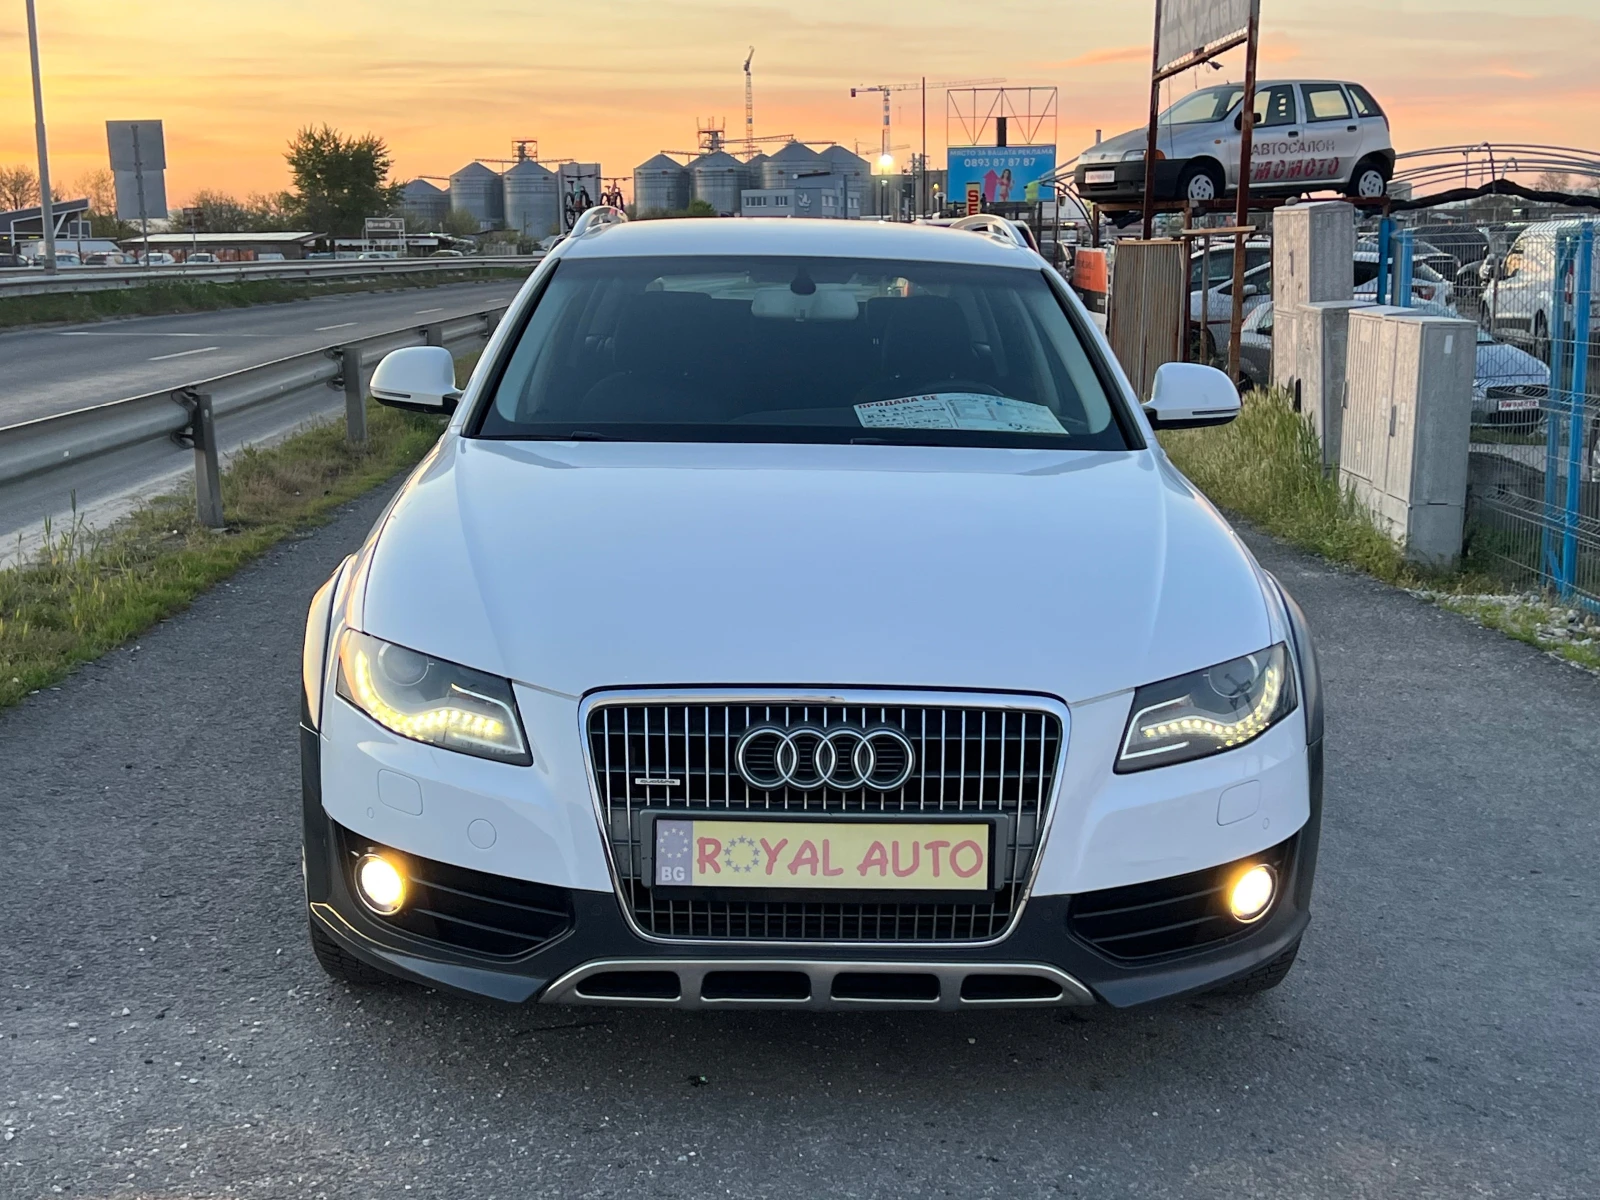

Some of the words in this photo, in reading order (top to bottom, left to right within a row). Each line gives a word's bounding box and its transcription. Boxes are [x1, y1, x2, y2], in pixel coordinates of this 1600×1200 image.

[1251, 139, 1335, 156] АВТОСАЛОН
[964, 158, 990, 168] 0893
[993, 158, 1005, 167] 87
[1008, 158, 1020, 167] 87
[1023, 157, 1036, 166] 87
[858, 397, 919, 409] ПРОДАВА
[856, 840, 984, 878] AUTO
[661, 866, 685, 882] BG
